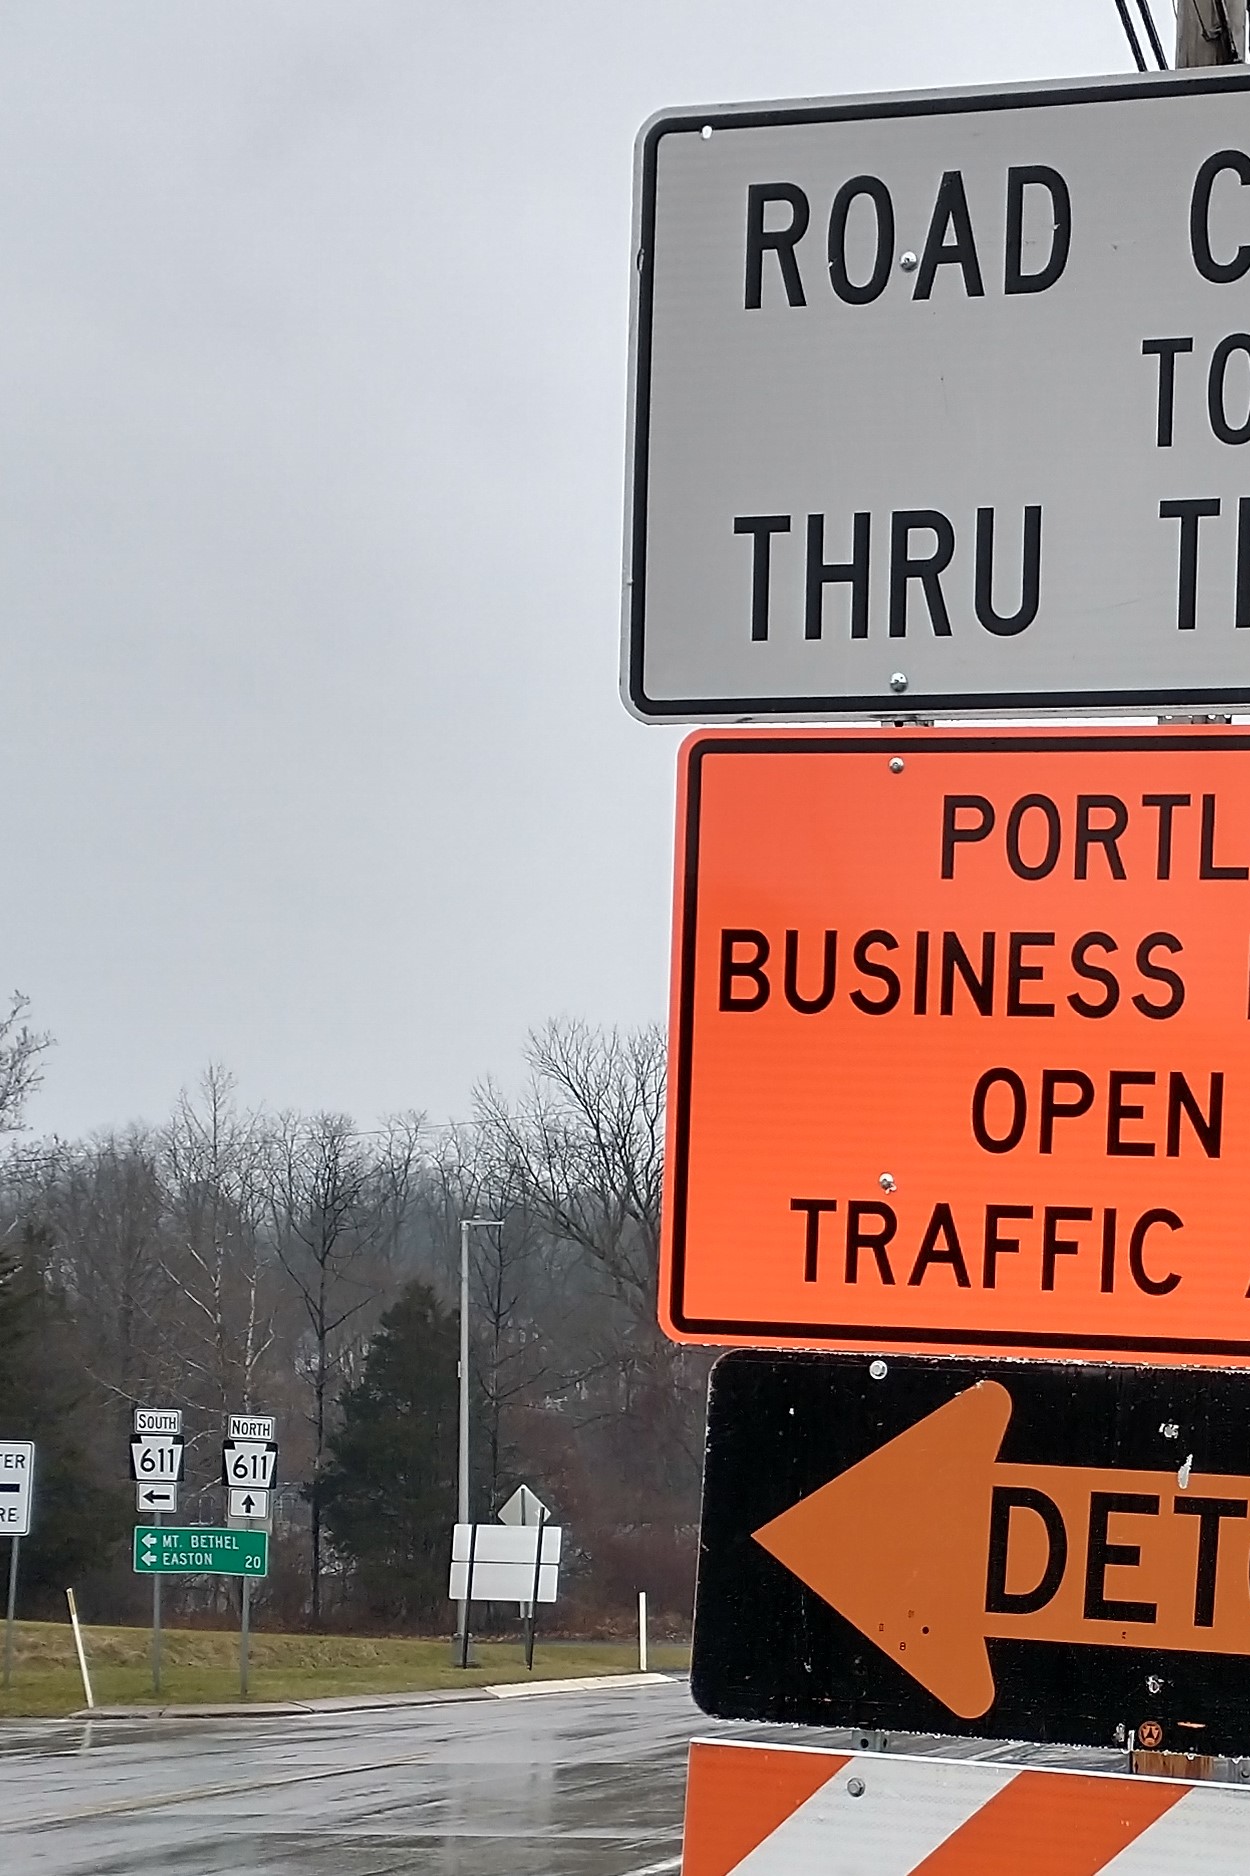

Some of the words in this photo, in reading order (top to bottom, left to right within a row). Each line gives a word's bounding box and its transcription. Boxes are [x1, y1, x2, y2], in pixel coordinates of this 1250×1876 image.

[745, 164, 1072, 309] ROAD
[734, 504, 1042, 642] THRU
[719, 929, 1185, 1020] BUSINESS
[972, 1067, 1224, 1158] OPEN
[790, 1198, 1184, 1295] TRAFFIC
[139, 1414, 177, 1430] SOUTH
[232, 1420, 271, 1437] NORTH
[140, 1448, 174, 1473] 611
[233, 1454, 267, 1480] 611
[162, 1535, 183, 1548] MT.
[191, 1535, 240, 1550] BETHEL
[162, 1553, 213, 1566] EASTON
[245, 1556, 261, 1569] 20
